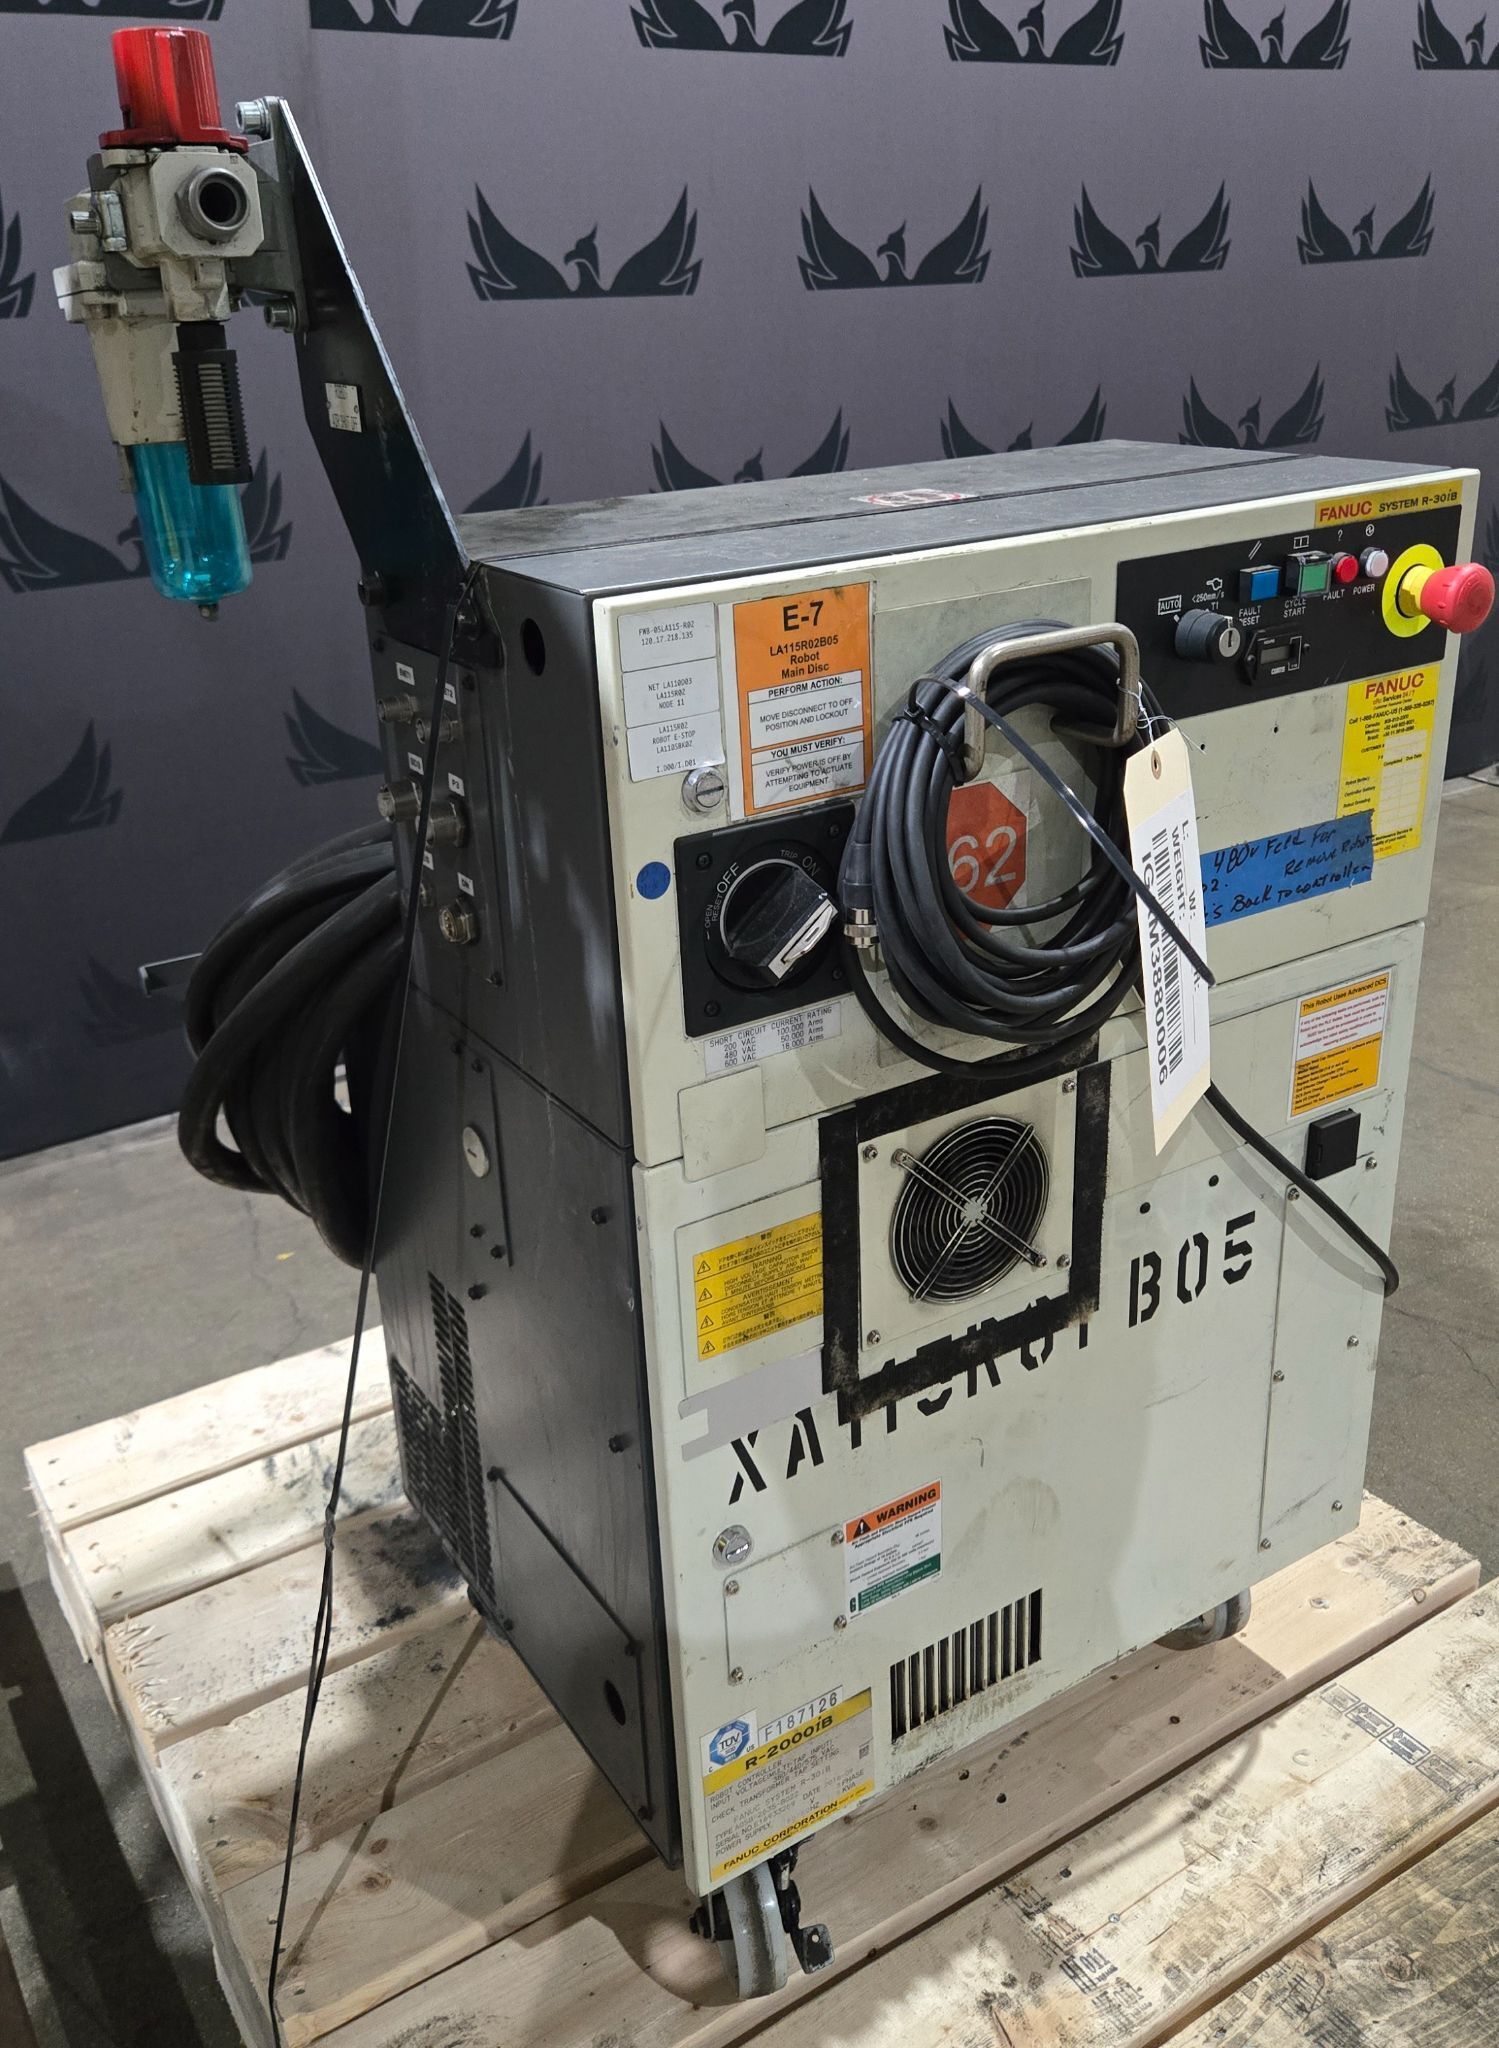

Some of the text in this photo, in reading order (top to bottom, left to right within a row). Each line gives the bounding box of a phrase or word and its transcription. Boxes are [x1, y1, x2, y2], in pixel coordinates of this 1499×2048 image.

[1320, 500, 1372, 522] FANUC
[1379, 498, 1418, 512] SYSTEM
[1353, 584, 1375, 595] POWER
[783, 600, 824, 632] E-7
[1160, 599, 1180, 611] AUTO
[1238, 605, 1262, 617] FAULT
[1283, 606, 1307, 618] START
[769, 634, 839, 657] LA115R02B05
[790, 651, 820, 665] Robot
[781, 663, 829, 680] Main Disc
[648, 683, 660, 692] NET
[768, 676, 843, 698] PERFORM ACTION:
[1365, 673, 1424, 699] FANUC
[658, 698, 685, 709] NODE 11
[759, 697, 853, 723] MOVE DISCONNECT TO OFF
[765, 708, 849, 732] POSITION AND LOCKOUT
[652, 729, 696, 745] ROBOT E-STOP
[771, 736, 846, 760] YOU MUST VERIFY:
[765, 752, 852, 778] VERIFY POWER IS OFF BY
[765, 762, 853, 788] ATTEMPTING TO ACTUATE
[716, 862, 741, 894] OFF
[802, 856, 820, 876] ON
[1171, 826, 1188, 920] WEIGHT:
[704, 904, 713, 928] OPEN
[1316, 996, 1332, 1006] Robot
[1375, 977, 1387, 989] DCS
[709, 1006, 832, 1048] SHORT CIRCUIT CURRENT RATING
[724, 1042, 737, 1052] 200
[742, 1037, 756, 1047] VAC
[742, 1045, 756, 1055] VAC
[742, 1053, 757, 1063] VAC
[752, 1254, 782, 1270] WARNING
[1129, 1210, 1256, 1329] B05
[743, 1277, 793, 1300] AVERTISSEMENT
[876, 1488, 937, 1524] WARNING
[764, 1692, 837, 1742] F187126
[745, 1714, 834, 1771] R-2000iB
[737, 1760, 783, 1788] CONTROLLER
[712, 1806, 735, 1823] CHECK
[723, 1846, 759, 1870] FANUC
[763, 1801, 838, 1847] CORPORATION
